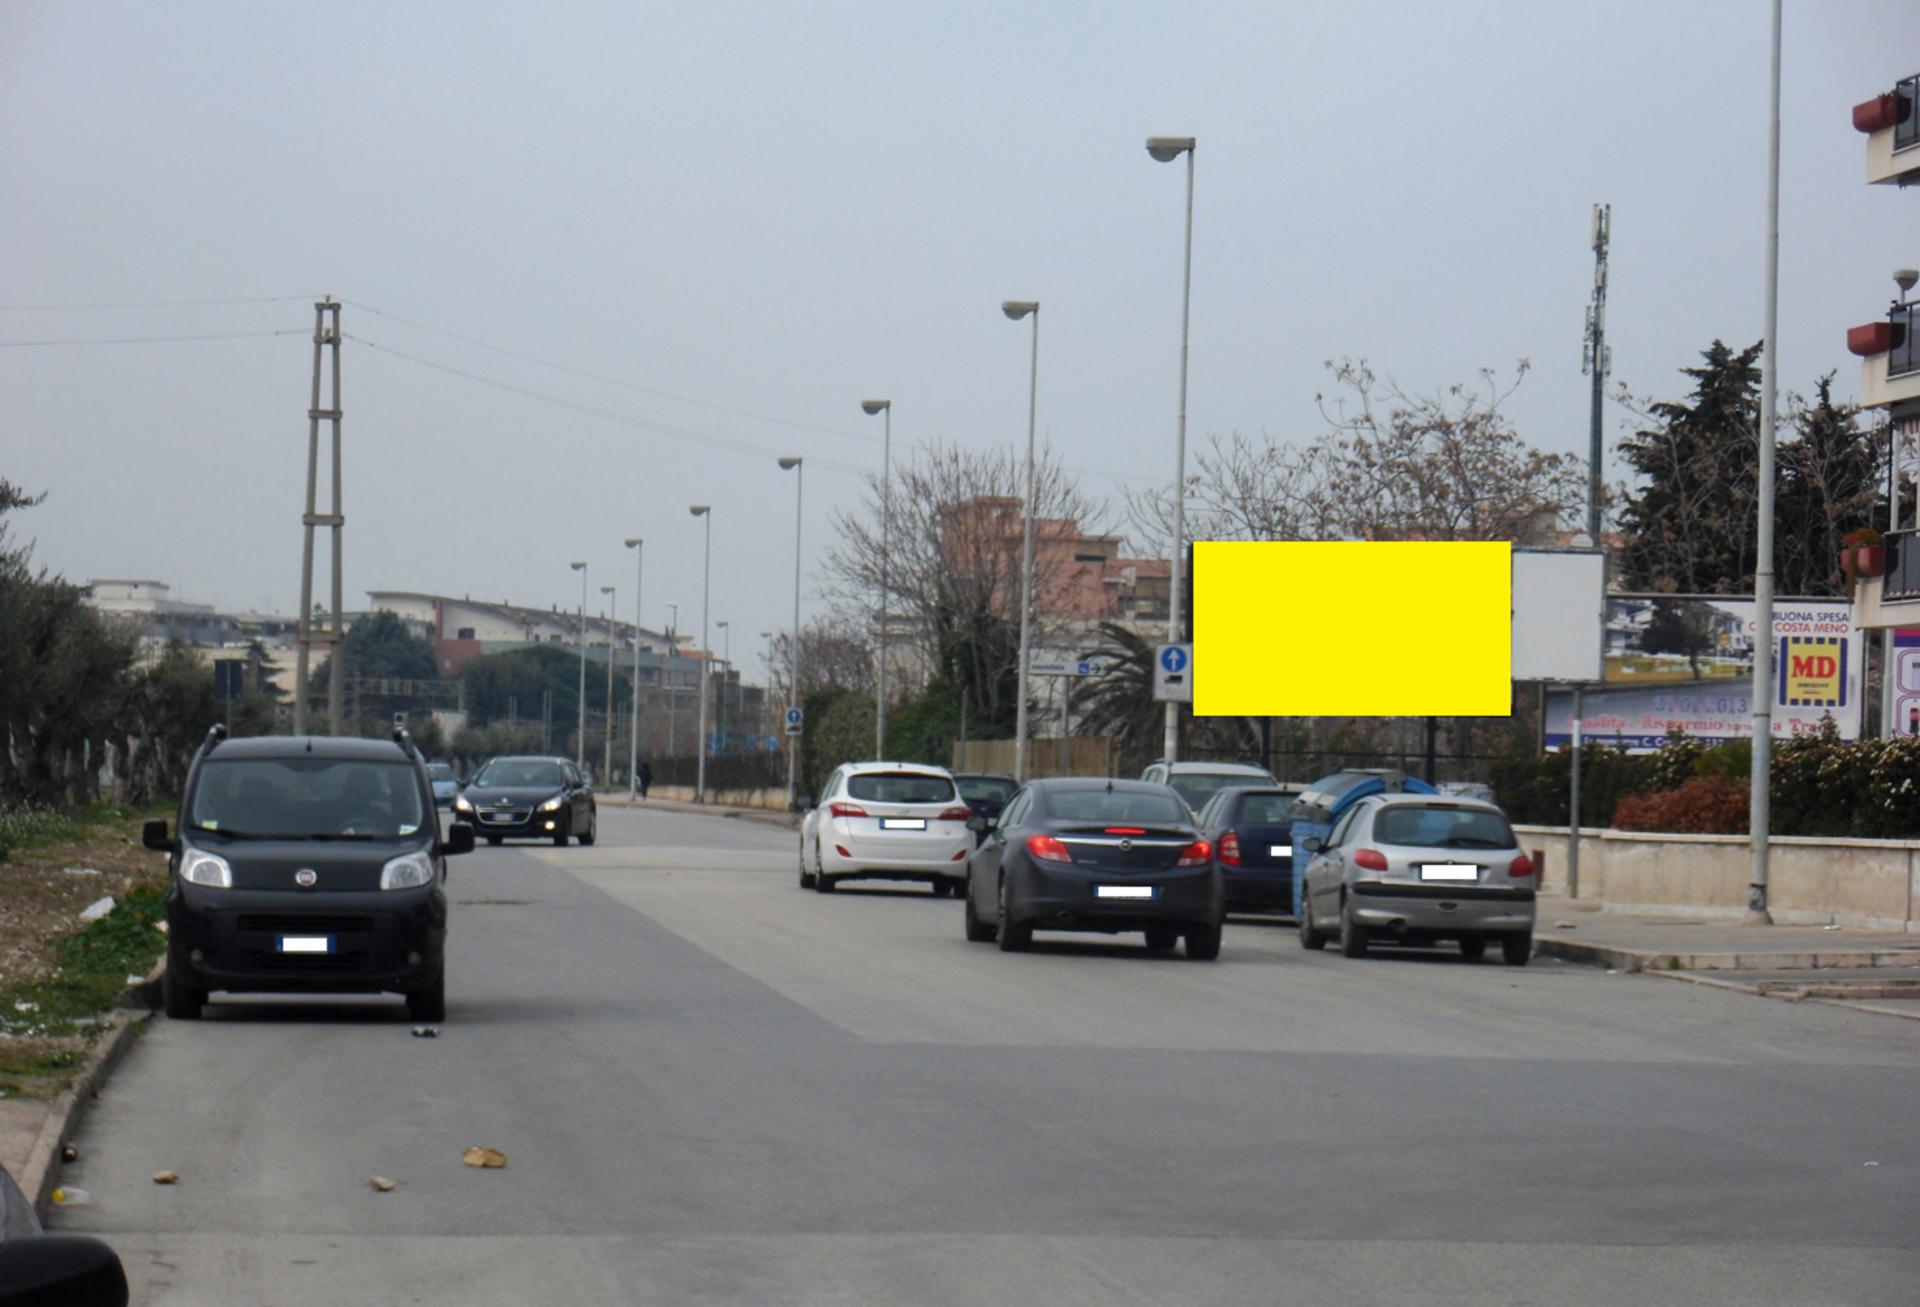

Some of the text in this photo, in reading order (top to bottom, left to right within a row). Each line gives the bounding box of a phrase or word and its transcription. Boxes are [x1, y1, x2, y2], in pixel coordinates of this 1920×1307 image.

[1771, 611, 1849, 622] BUONA SPESA
[1774, 622, 1811, 632] COSTA
[1814, 623, 1850, 633] MENO
[1791, 654, 1837, 679] MD
